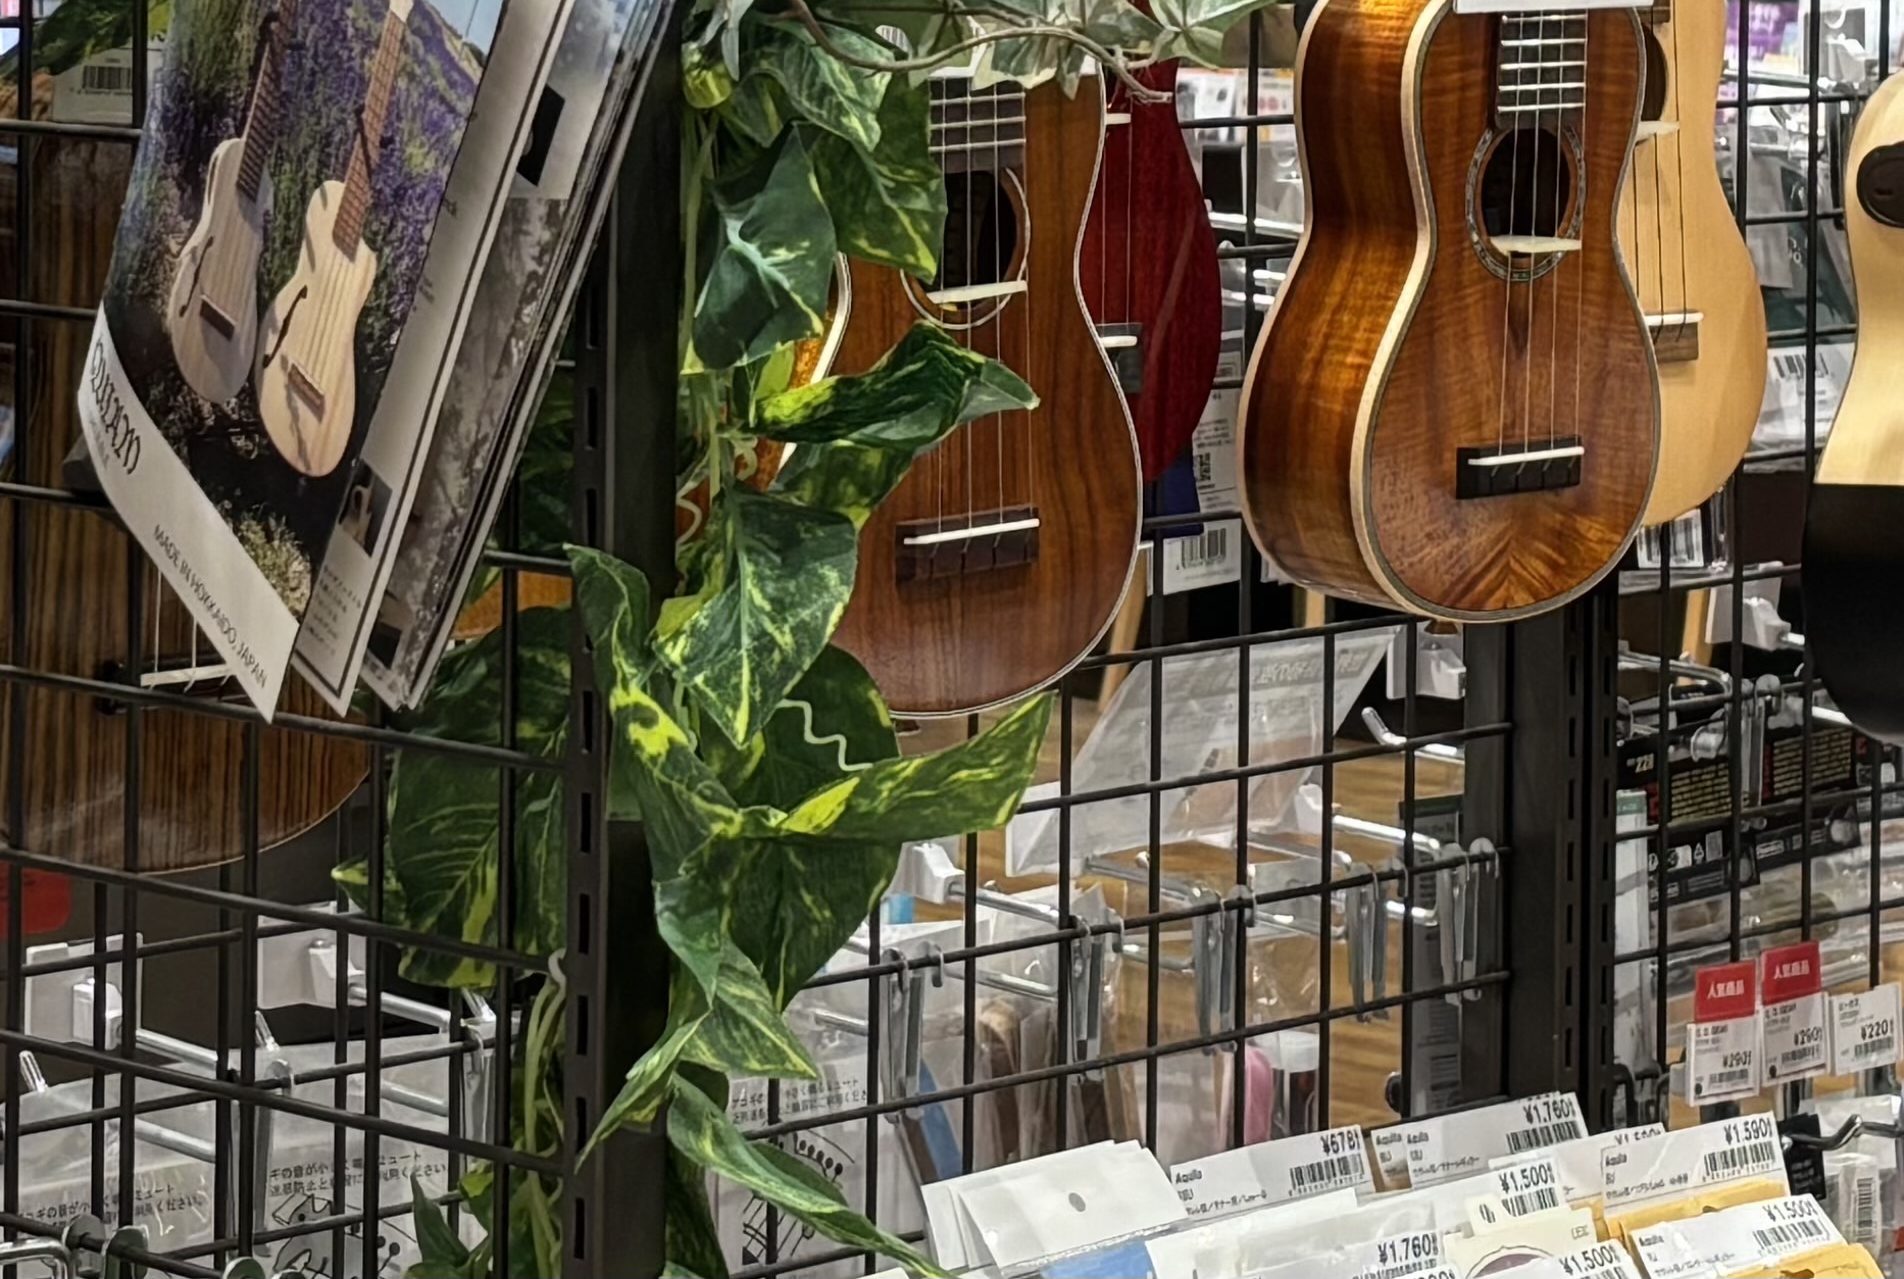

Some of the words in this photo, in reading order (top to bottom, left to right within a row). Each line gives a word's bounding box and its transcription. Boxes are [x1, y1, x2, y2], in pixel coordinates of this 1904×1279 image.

[153, 523, 181, 569] MADE
[179, 562, 193, 584] IN
[190, 575, 238, 651] HOKKAIDO,
[235, 645, 268, 689] JAPAN
[1773, 959, 1811, 980] 人気商品
[1707, 979, 1745, 1001] 人気商品
[1523, 1097, 1572, 1125] ¥1,760
[1320, 1129, 1358, 1156] ¥678
[1723, 1117, 1771, 1145] ¥1,590
[1499, 1163, 1549, 1193] ¥1,500
[1762, 1198, 1812, 1223] ¥1,500
[1377, 1232, 1434, 1266] ¥1,760
[1558, 1244, 1615, 1275] ¥1,500
